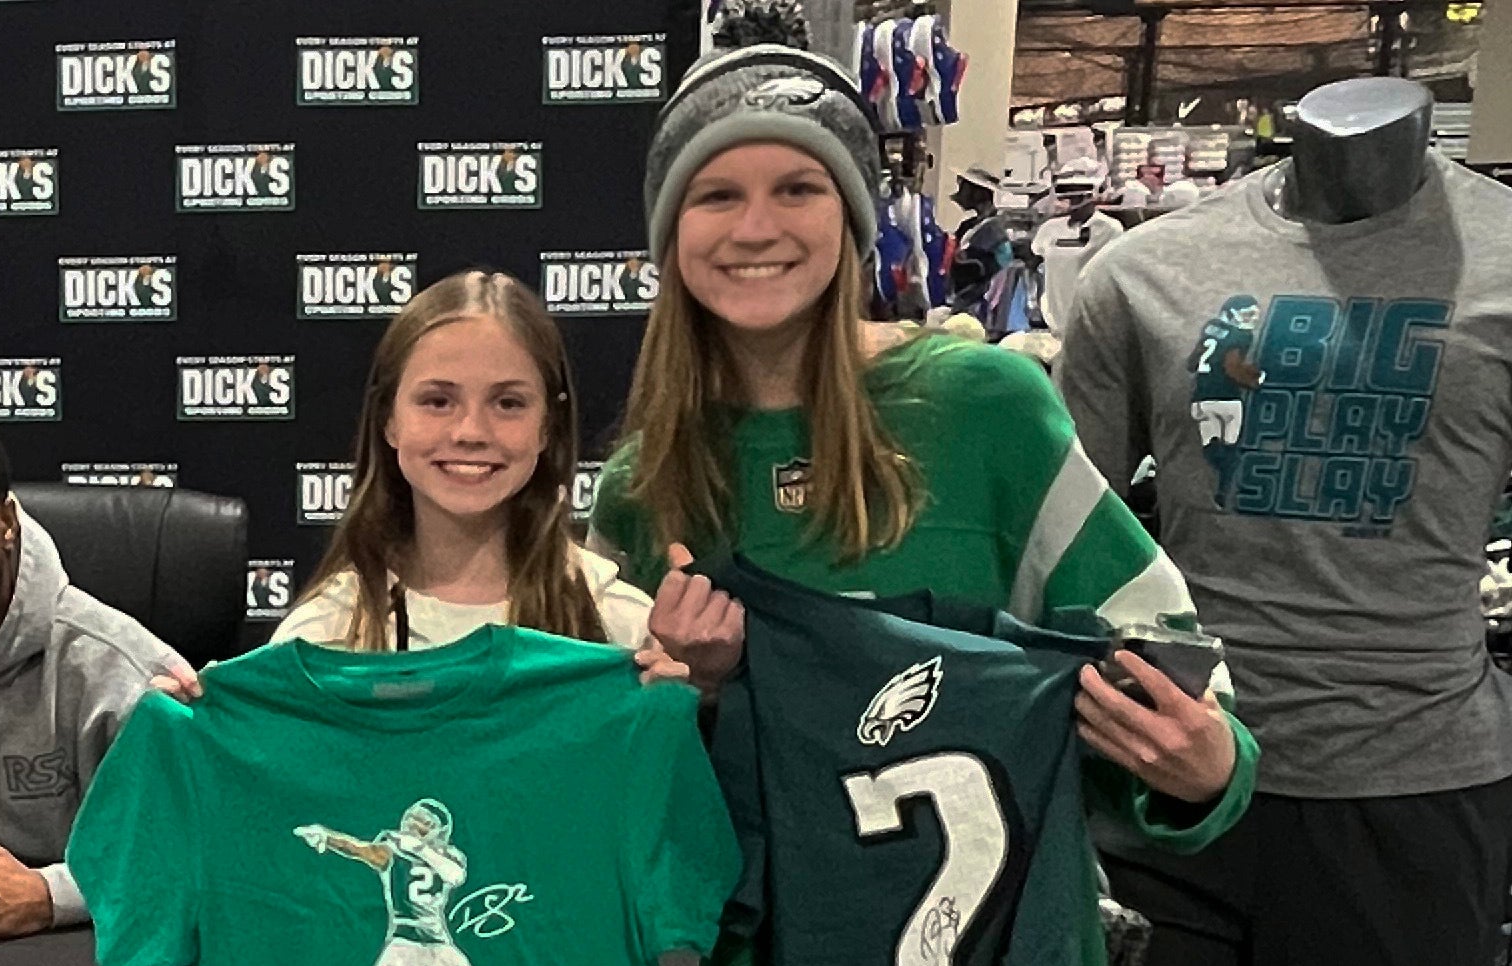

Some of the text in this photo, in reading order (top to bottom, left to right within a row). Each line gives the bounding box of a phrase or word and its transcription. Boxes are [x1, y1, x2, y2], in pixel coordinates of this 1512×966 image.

[1198, 339, 1219, 374] 2
[1256, 295, 1457, 396] BIG
[1242, 390, 1434, 456] PLAY
[1235, 452, 1418, 521] SLAY
[408, 866, 438, 903] 2
